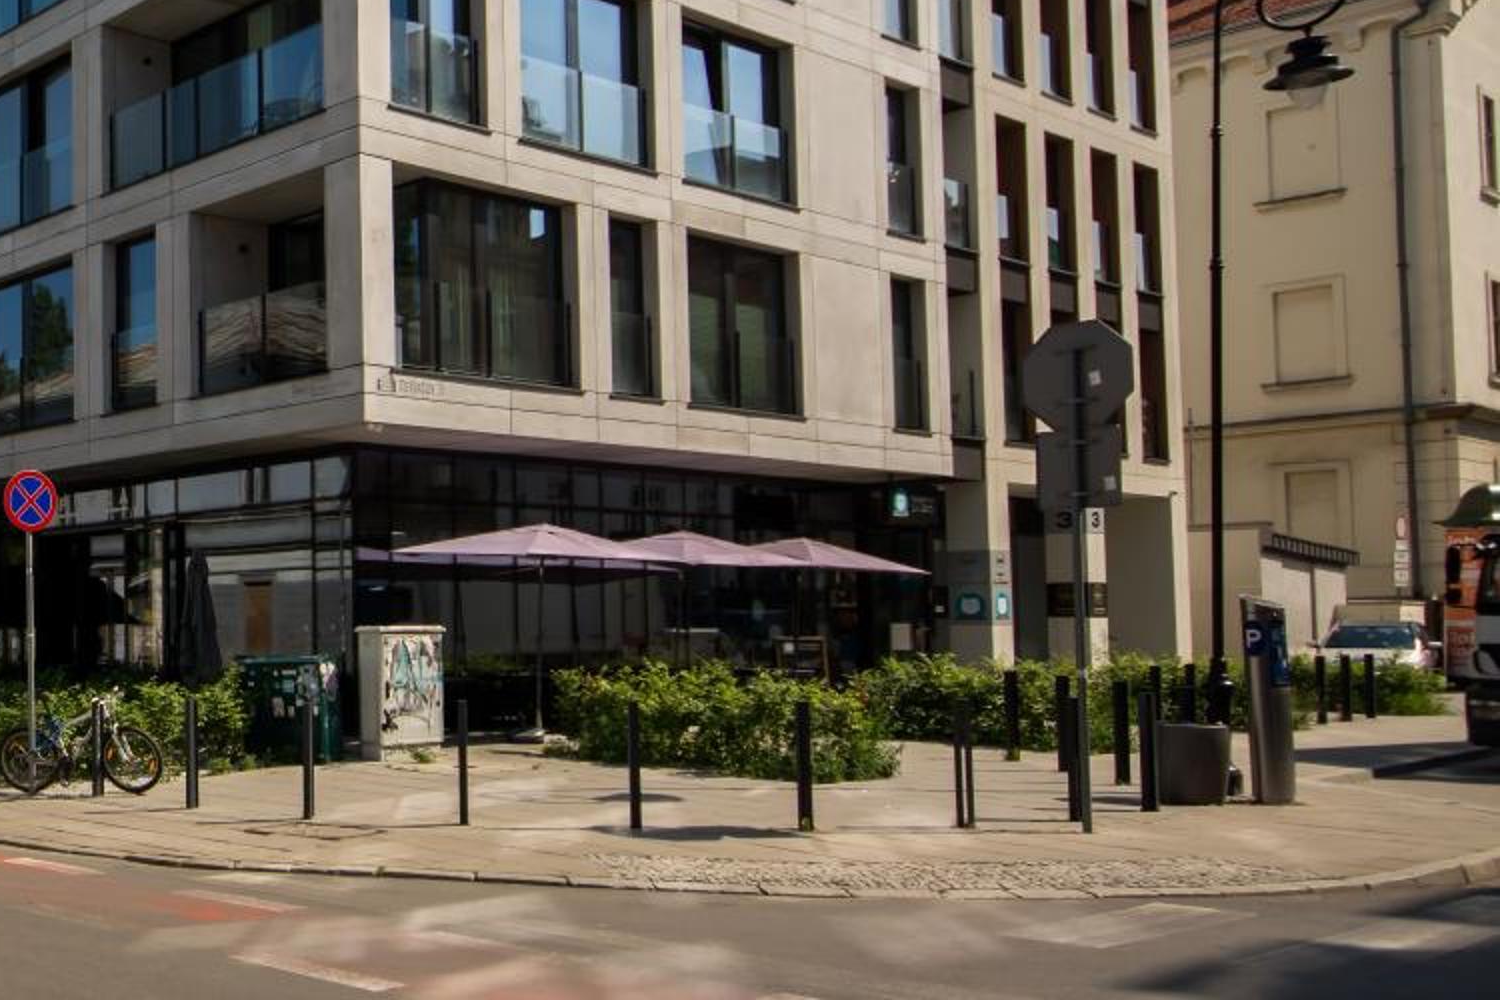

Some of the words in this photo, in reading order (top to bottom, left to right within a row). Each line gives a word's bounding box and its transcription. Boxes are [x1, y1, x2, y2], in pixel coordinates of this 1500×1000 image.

[1056, 511, 1073, 528] 3
[1091, 511, 1101, 528] 3
[1245, 629, 1262, 648] P
